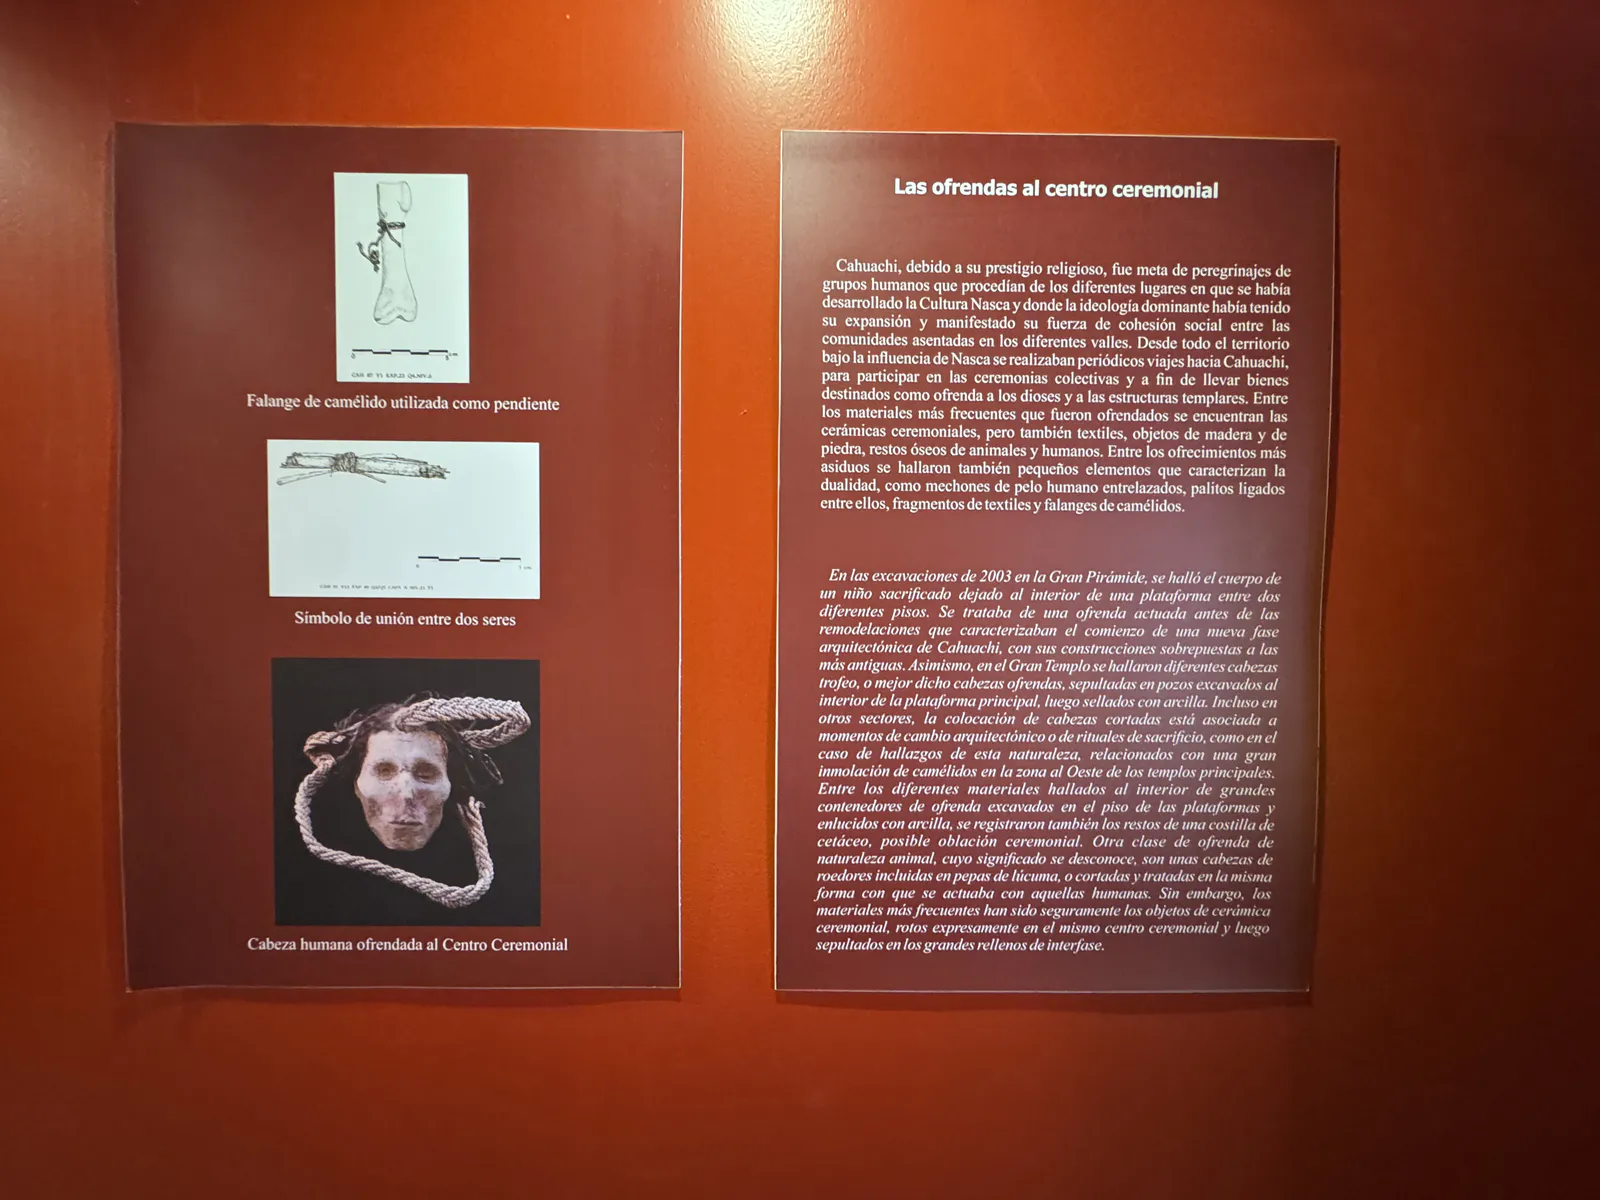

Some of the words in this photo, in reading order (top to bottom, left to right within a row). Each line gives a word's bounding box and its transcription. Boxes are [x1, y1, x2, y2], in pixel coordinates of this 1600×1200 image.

[895, 177, 927, 195] Las
[931, 177, 1018, 196] ofrendas
[1022, 179, 1040, 197] al
[1045, 181, 1108, 198] centro
[1112, 181, 1219, 199] ceremonial
[836, 258, 902, 275] Cahuachi,
[906, 259, 951, 274] debido
[954, 264, 963, 274] a
[966, 264, 982, 274] su
[985, 261, 1043, 278] prestigio
[1046, 261, 1107, 279] religioso,
[1112, 262, 1133, 276] fue
[1136, 265, 1168, 276] meta
[1172, 263, 1188, 277] de
[1192, 263, 1272, 281] peregrinajes
[1275, 264, 1292, 278] de
[822, 316, 837, 327] su
[845, 314, 911, 331] expansión
[919, 318, 928, 332] y
[936, 315, 1016, 329] manifestado
[1023, 319, 1039, 330] su
[1046, 316, 1087, 330] fuerza
[1094, 316, 1111, 331] de
[1118, 317, 1176, 332] cohesión
[1184, 318, 1222, 332] social
[1230, 320, 1264, 332] entre
[1272, 318, 1290, 332] las
[822, 371, 850, 385] para
[857, 368, 920, 386] participar
[926, 373, 942, 383] en
[949, 369, 968, 384] las
[974, 370, 1048, 384] ceremonias
[1054, 371, 1120, 385] colectivas
[1125, 376, 1135, 389] y
[1141, 376, 1150, 386] a
[1156, 372, 1174, 386] fin
[1180, 372, 1196, 386] de
[1203, 372, 1241, 386] llevar
[1247, 373, 1289, 387] bienes
[247, 393, 301, 411] Falange
[304, 394, 322, 408] de
[324, 394, 387, 409] camélido
[390, 395, 449, 410] utilizada
[452, 399, 491, 410] como
[493, 396, 560, 414] pendiente
[821, 423, 887, 437] cerámicas
[891, 424, 981, 441] ceremoniales,
[985, 428, 1015, 442] pero
[1020, 425, 1072, 439] también
[1077, 426, 1128, 442] textiles,
[1132, 426, 1180, 444] objetos
[1184, 427, 1200, 441] de
[1205, 427, 1253, 441] madera
[1257, 431, 1267, 444] y
[1271, 427, 1287, 441] de
[820, 459, 870, 474] asiduos
[876, 463, 891, 474] se
[897, 460, 951, 474] hallaron
[958, 461, 1011, 475] también
[1017, 462, 1079, 479] pequeños
[1085, 462, 1151, 476] elementos
[1157, 466, 1182, 480] que
[1188, 463, 1267, 477] caracterizan
[1274, 464, 1286, 477] la
[828, 568, 847, 582] En
[850, 568, 870, 582] las
[872, 569, 958, 583] excavaciones
[960, 569, 977, 583] de
[979, 569, 1012, 583] 2003
[1014, 573, 1031, 583] en
[1033, 570, 1047, 583] la
[1049, 570, 1083, 583] Gran
[1085, 570, 1148, 585] Pirámide,
[1151, 575, 1166, 584] se
[1168, 571, 1201, 584] halló
[1203, 571, 1217, 584] el
[1218, 575, 1263, 588] cuerpo
[1265, 572, 1282, 585] de
[294, 610, 352, 625] Símbolo
[355, 611, 372, 625] de
[375, 611, 414, 625] unión
[417, 614, 452, 626] entre
[455, 612, 479, 626] dos
[482, 616, 516, 626] seres
[819, 621, 921, 636] remodelaciones
[928, 626, 953, 639] que
[959, 623, 1058, 637] caracterizaban
[1064, 623, 1078, 637] el
[1084, 624, 1145, 637] comienzo
[1152, 624, 1168, 637] de
[1175, 628, 1200, 637] una
[1207, 628, 1246, 638] nueva
[1249, 624, 1280, 641] fase
[818, 713, 852, 724] otros
[858, 713, 915, 726] sectores,
[923, 711, 937, 725] la
[944, 711, 1016, 725] colocación
[1023, 711, 1040, 725] de
[1046, 712, 1098, 726] cabezas
[1105, 712, 1162, 726] cortadas
[1169, 713, 1196, 726] está
[1202, 713, 1261, 726] asociada
[1268, 717, 1278, 726] a
[817, 782, 856, 795] Entre
[863, 781, 884, 795] los
[891, 781, 960, 798] diferentes
[967, 782, 1040, 795] materiales
[1047, 782, 1107, 796] hallados
[1114, 782, 1129, 796] al
[1136, 783, 1189, 795] interior
[1196, 782, 1213, 796] de
[1219, 783, 1276, 799] grandes
[817, 834, 872, 848] cetáceo,
[879, 834, 931, 850] posible
[938, 834, 997, 848] oblación
[1005, 834, 1083, 848] ceremonial.
[1092, 834, 1124, 848] Otra
[1131, 834, 1167, 848] clase
[1174, 834, 1191, 848] de
[1198, 835, 1250, 851] ofrenda
[1257, 835, 1274, 848] de
[813, 886, 855, 902] forma
[861, 889, 886, 899] con
[891, 889, 916, 902] que
[921, 889, 937, 899] se
[942, 886, 995, 899] actuaba
[1000, 890, 1025, 900] con
[1030, 886, 1085, 903] aquellas
[1091, 886, 1151, 900] humanas.
[1158, 886, 1180, 899] Sin
[1186, 886, 1244, 903] embargo,
[1252, 887, 1272, 900] los
[247, 937, 297, 951] Cabeza
[300, 937, 353, 951] humana
[356, 937, 423, 951] ofrendada
[426, 937, 438, 951] al
[442, 937, 488, 951] Centro
[491, 937, 568, 952] Ceremonial
